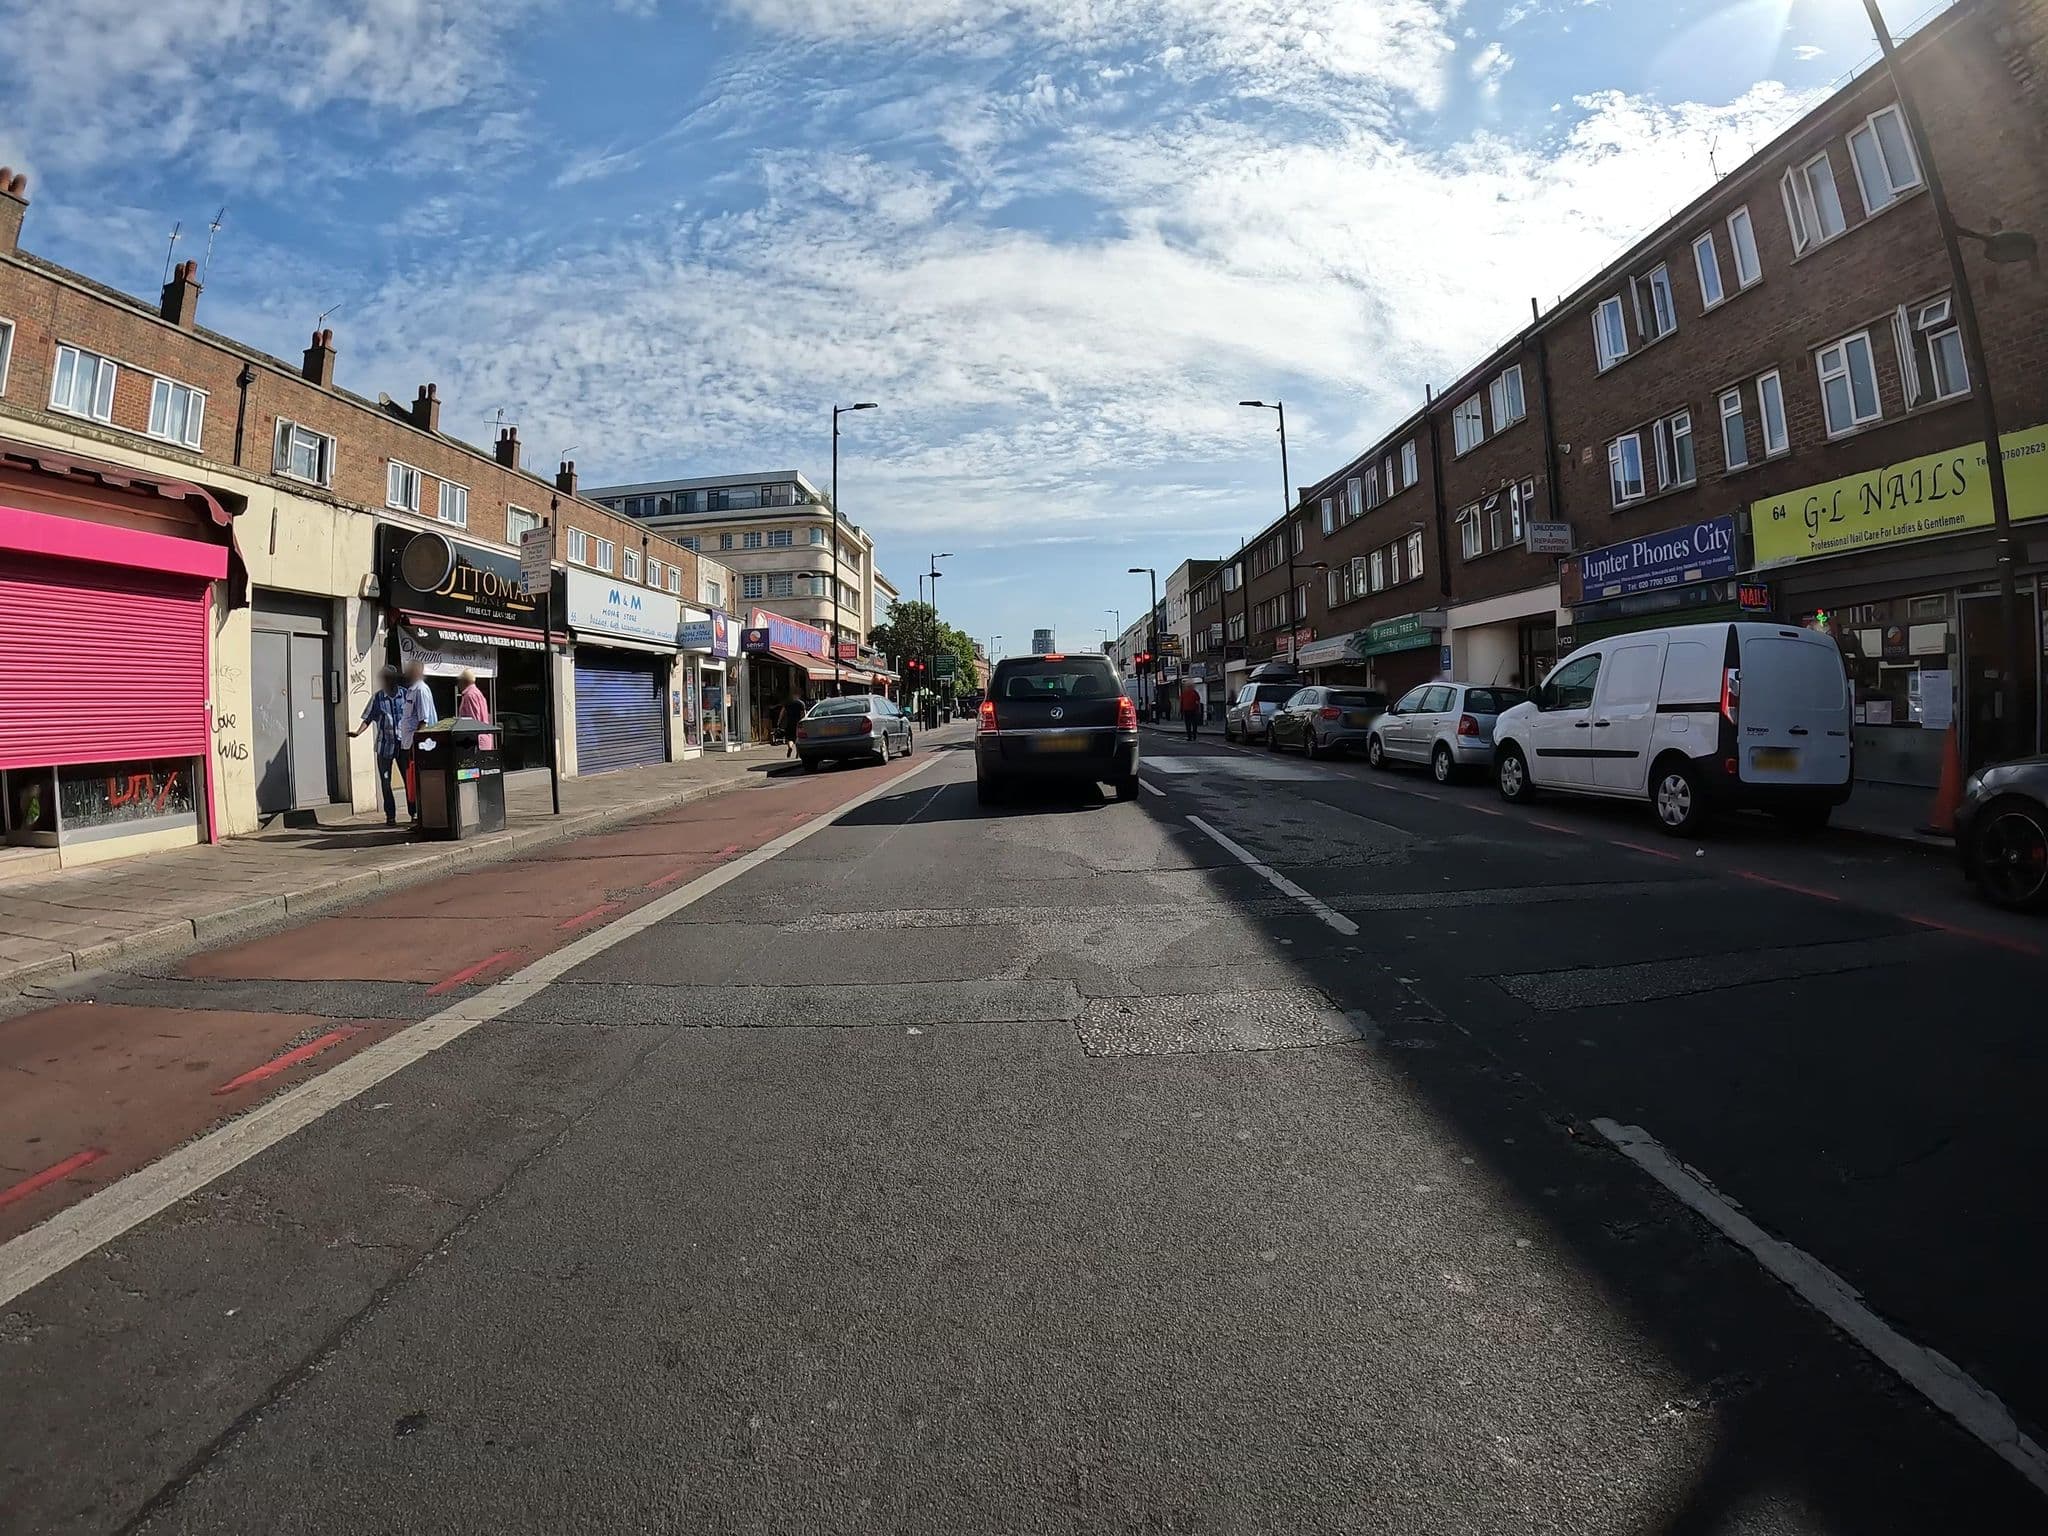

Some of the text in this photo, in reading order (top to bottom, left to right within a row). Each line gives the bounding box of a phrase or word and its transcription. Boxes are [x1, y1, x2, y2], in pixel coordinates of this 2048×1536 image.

[1859, 458, 1967, 516] NAILS
[1772, 505, 1786, 521] 64
[1811, 514, 1966, 551] Professional Nail Care For Ladies & Gentlemen
[1583, 522, 1733, 581] Jupiter Phones City
[1638, 579, 1649, 589] 020
[1649, 577, 1664, 588] 7700
[609, 589, 642, 610] M & M
[1740, 587, 1768, 606] NAILS
[438, 630, 459, 641] WRAPS
[487, 636, 511, 647] BURGERS
[1379, 622, 1413, 638] HERBAL TREE
